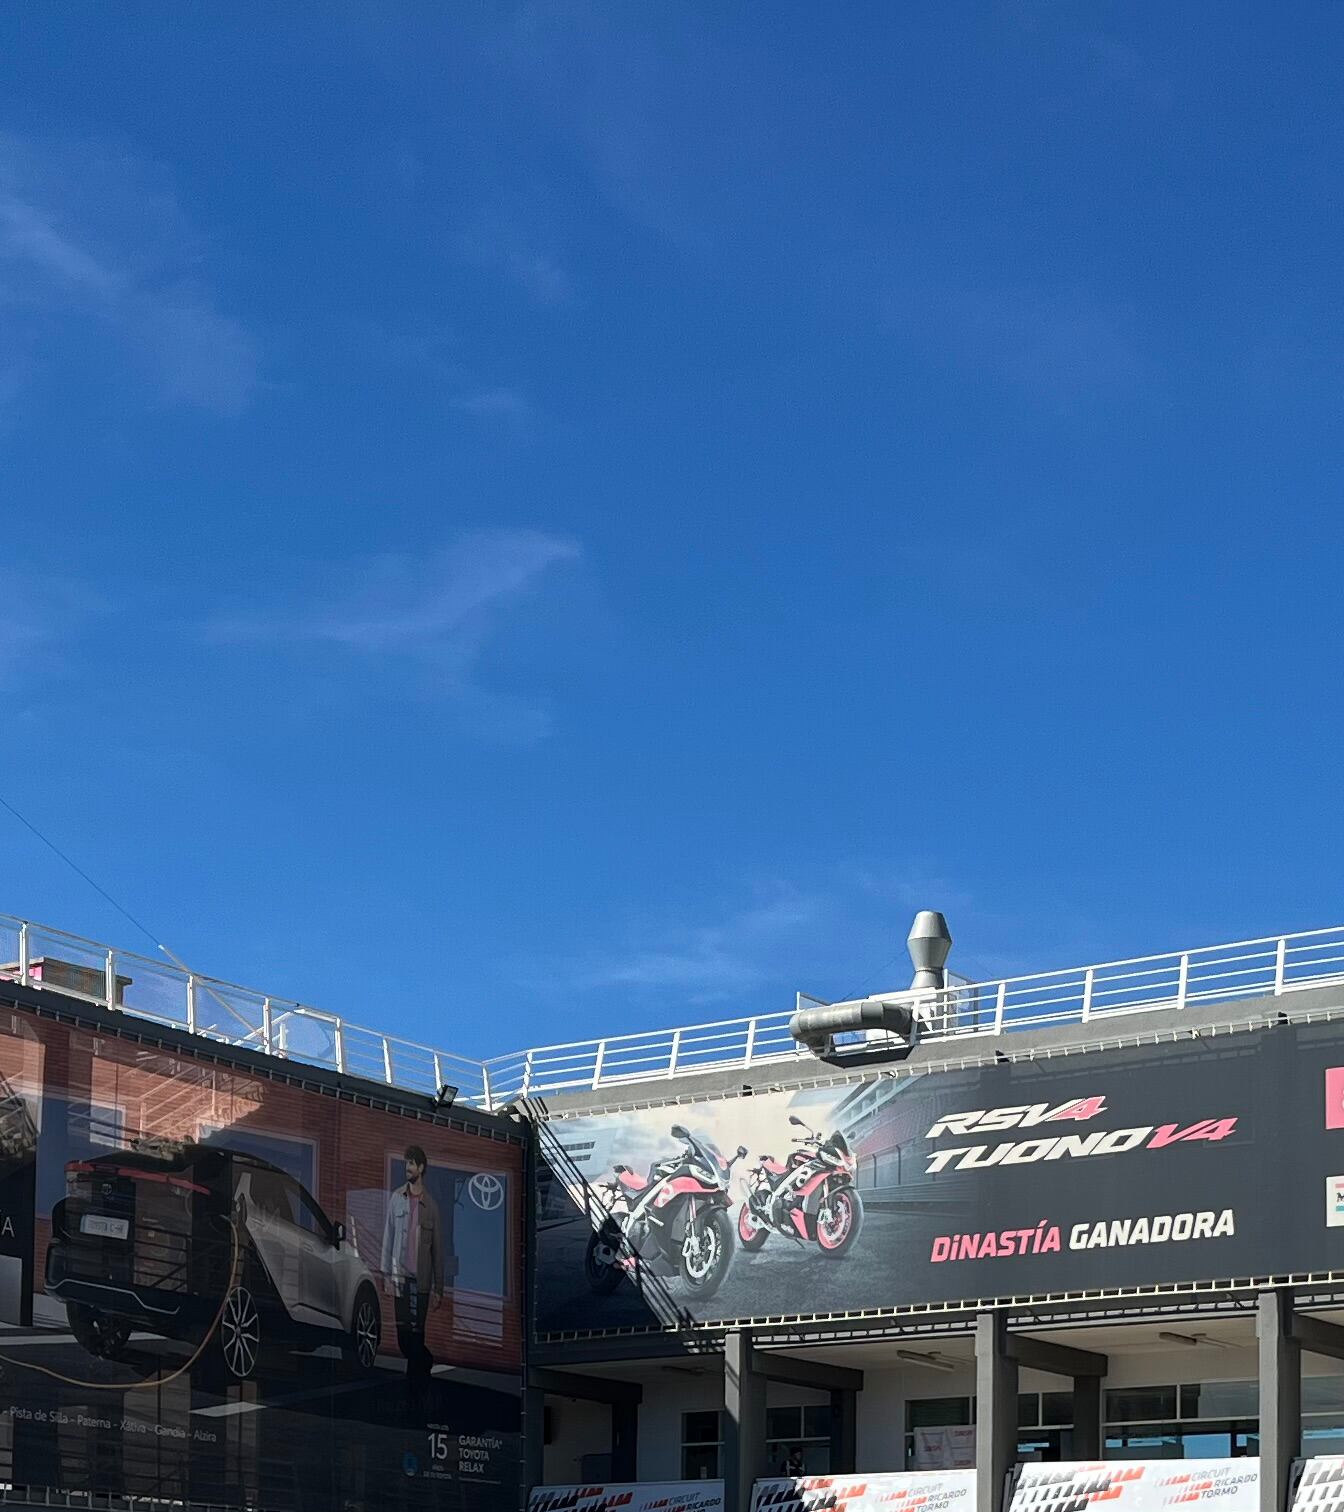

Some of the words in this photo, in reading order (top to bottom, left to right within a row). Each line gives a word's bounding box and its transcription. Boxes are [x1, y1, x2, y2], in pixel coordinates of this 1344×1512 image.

[925, 1095, 1107, 1138] RSV4
[1069, 1209, 1235, 1250] GANADORA
[9, 1406, 33, 1419] Pista
[34, 1410, 48, 1421] de
[49, 1411, 68, 1424] Silla
[77, 1414, 111, 1429] Paterna
[194, 1429, 217, 1442] Alzira
[427, 1433, 448, 1460] 15
[458, 1447, 490, 1461] TOYOTA
[458, 1461, 485, 1474] RELAX
[1191, 1466, 1232, 1482] CIRCUIT
[1213, 1473, 1258, 1488] RICARDO
[908, 1482, 944, 1498] CIRCUIT
[927, 1488, 968, 1502] RICARDO
[1201, 1485, 1238, 1499] TORMO
[668, 1491, 702, 1506] CIRCUIT
[686, 1497, 722, 1511] RICARDO
